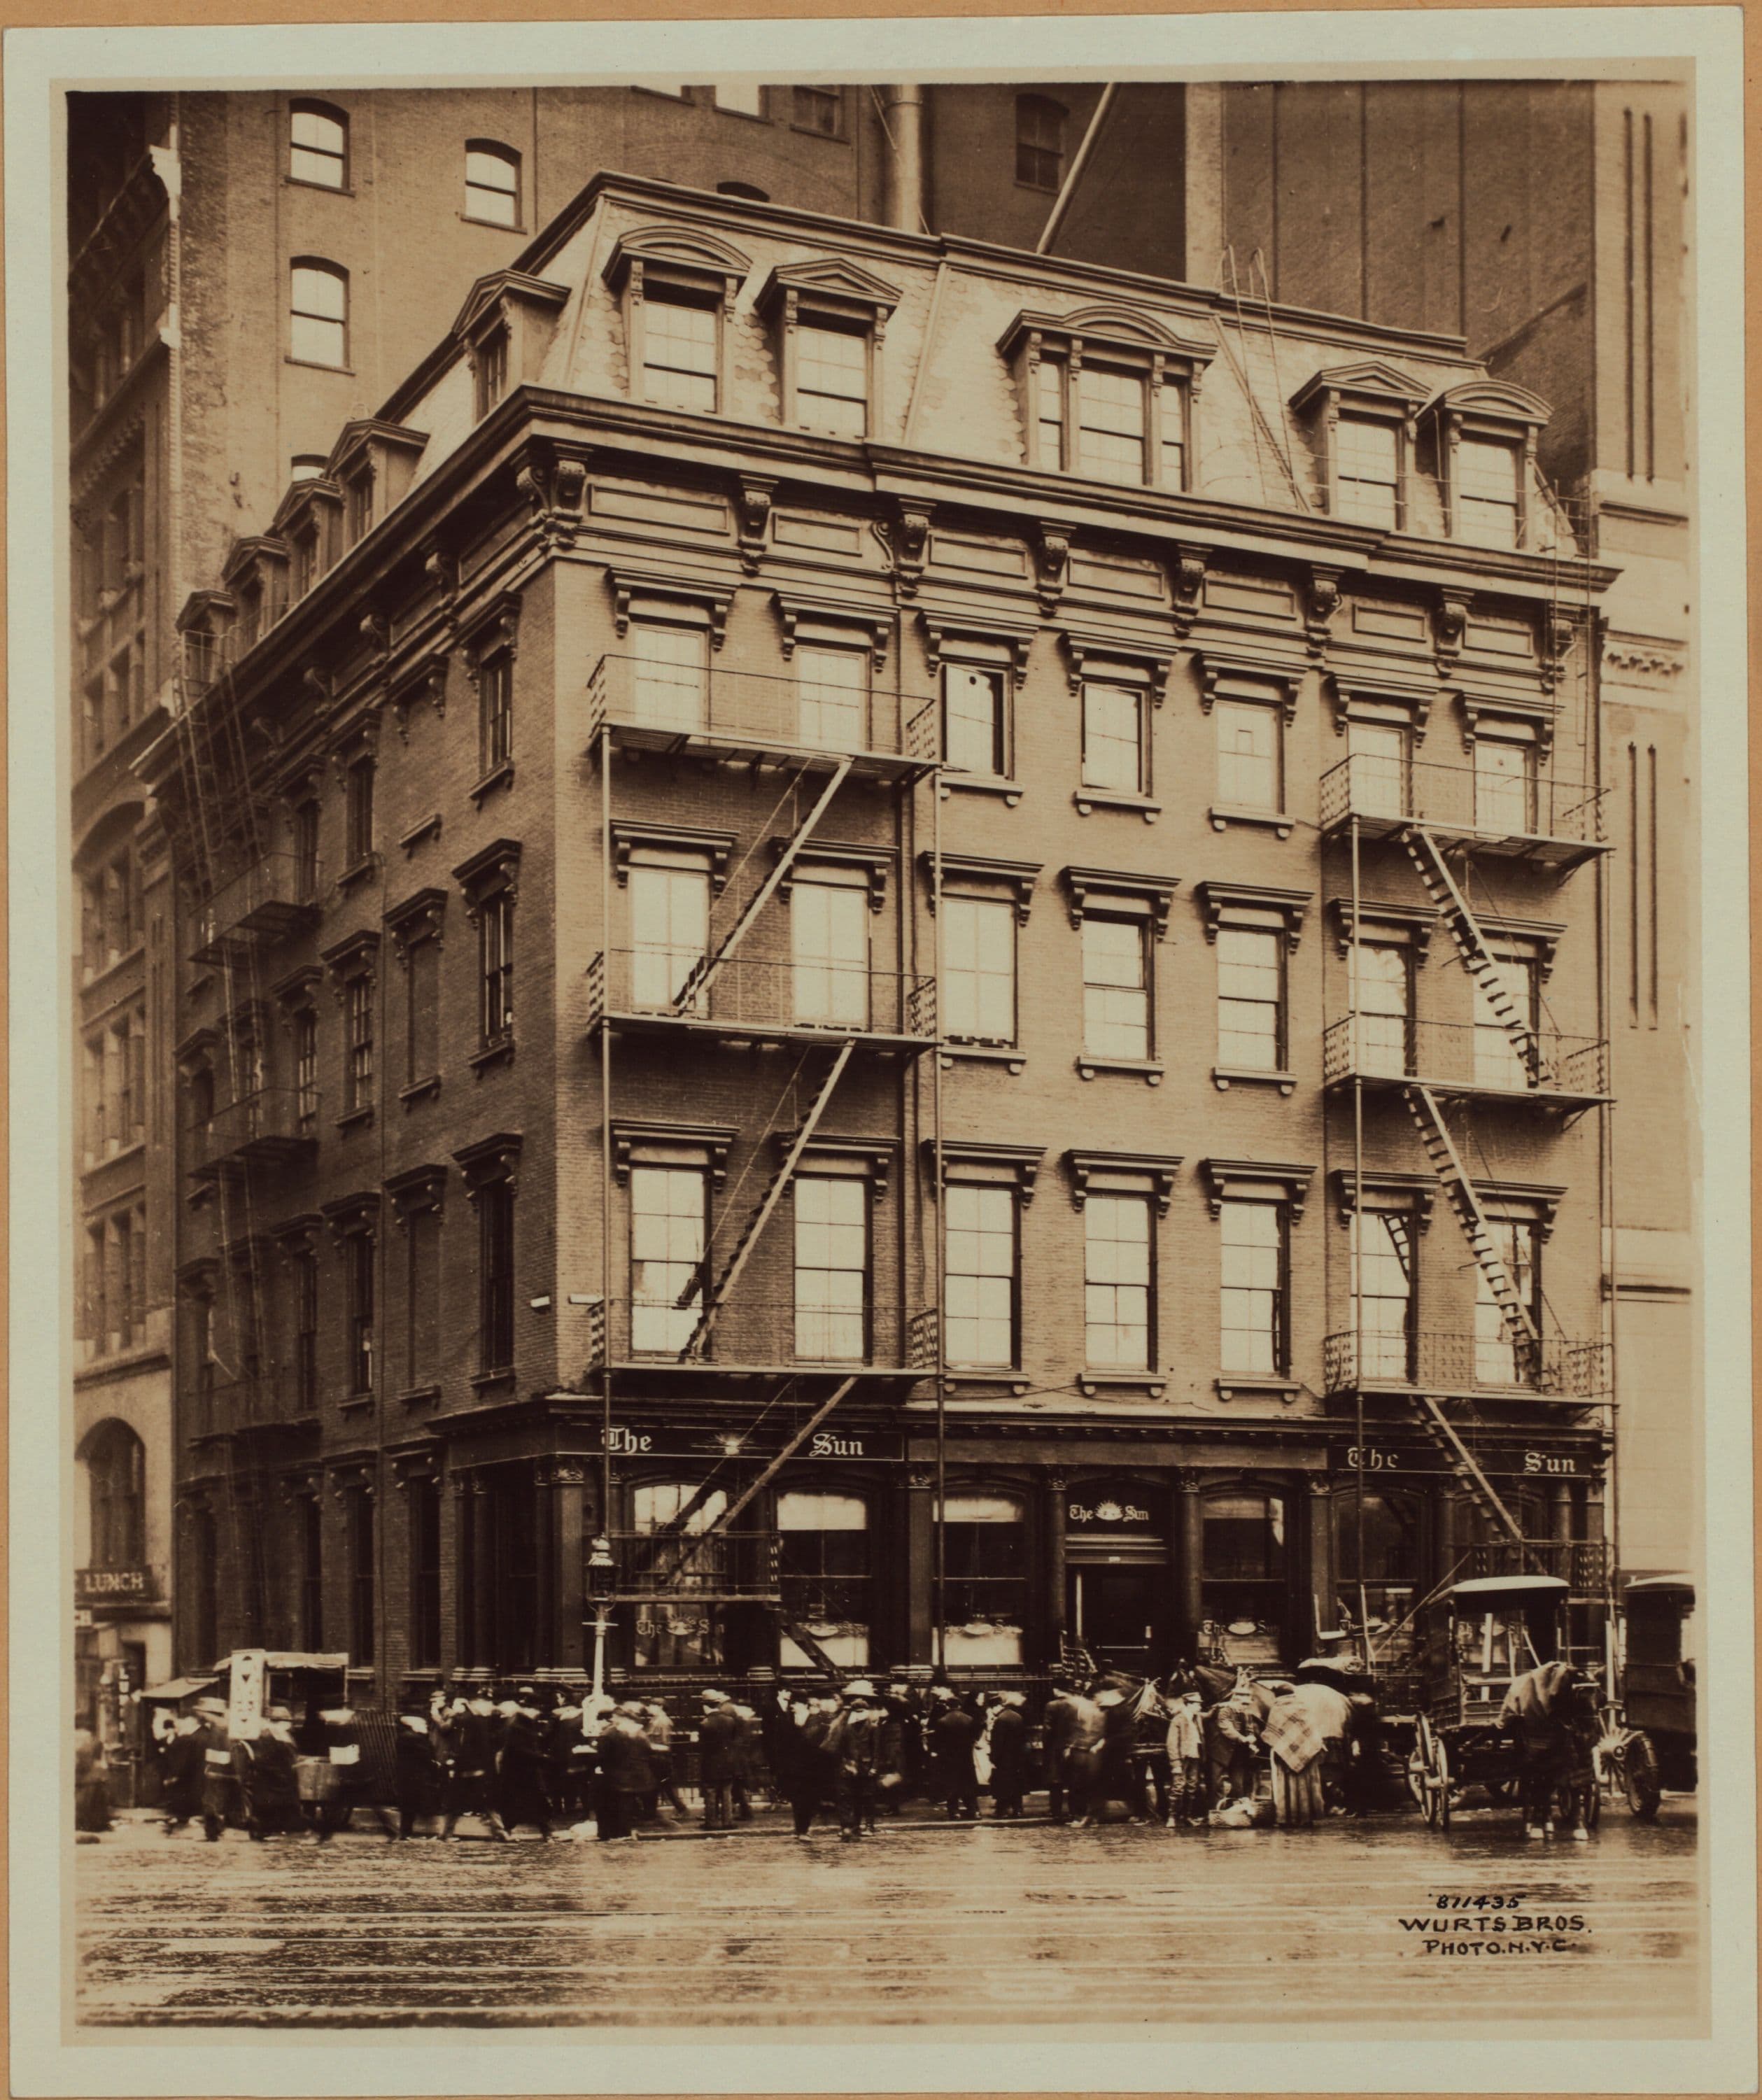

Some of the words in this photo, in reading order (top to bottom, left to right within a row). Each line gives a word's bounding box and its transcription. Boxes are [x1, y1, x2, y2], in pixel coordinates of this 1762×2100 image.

[600, 1427, 652, 1454] The
[808, 1433, 864, 1457] Sun
[1347, 1446, 1399, 1470] The
[1523, 1449, 1576, 1474] Sun
[1069, 1504, 1094, 1523] The
[1122, 1505, 1150, 1523] Sun
[84, 1572, 144, 1593] LUNCH
